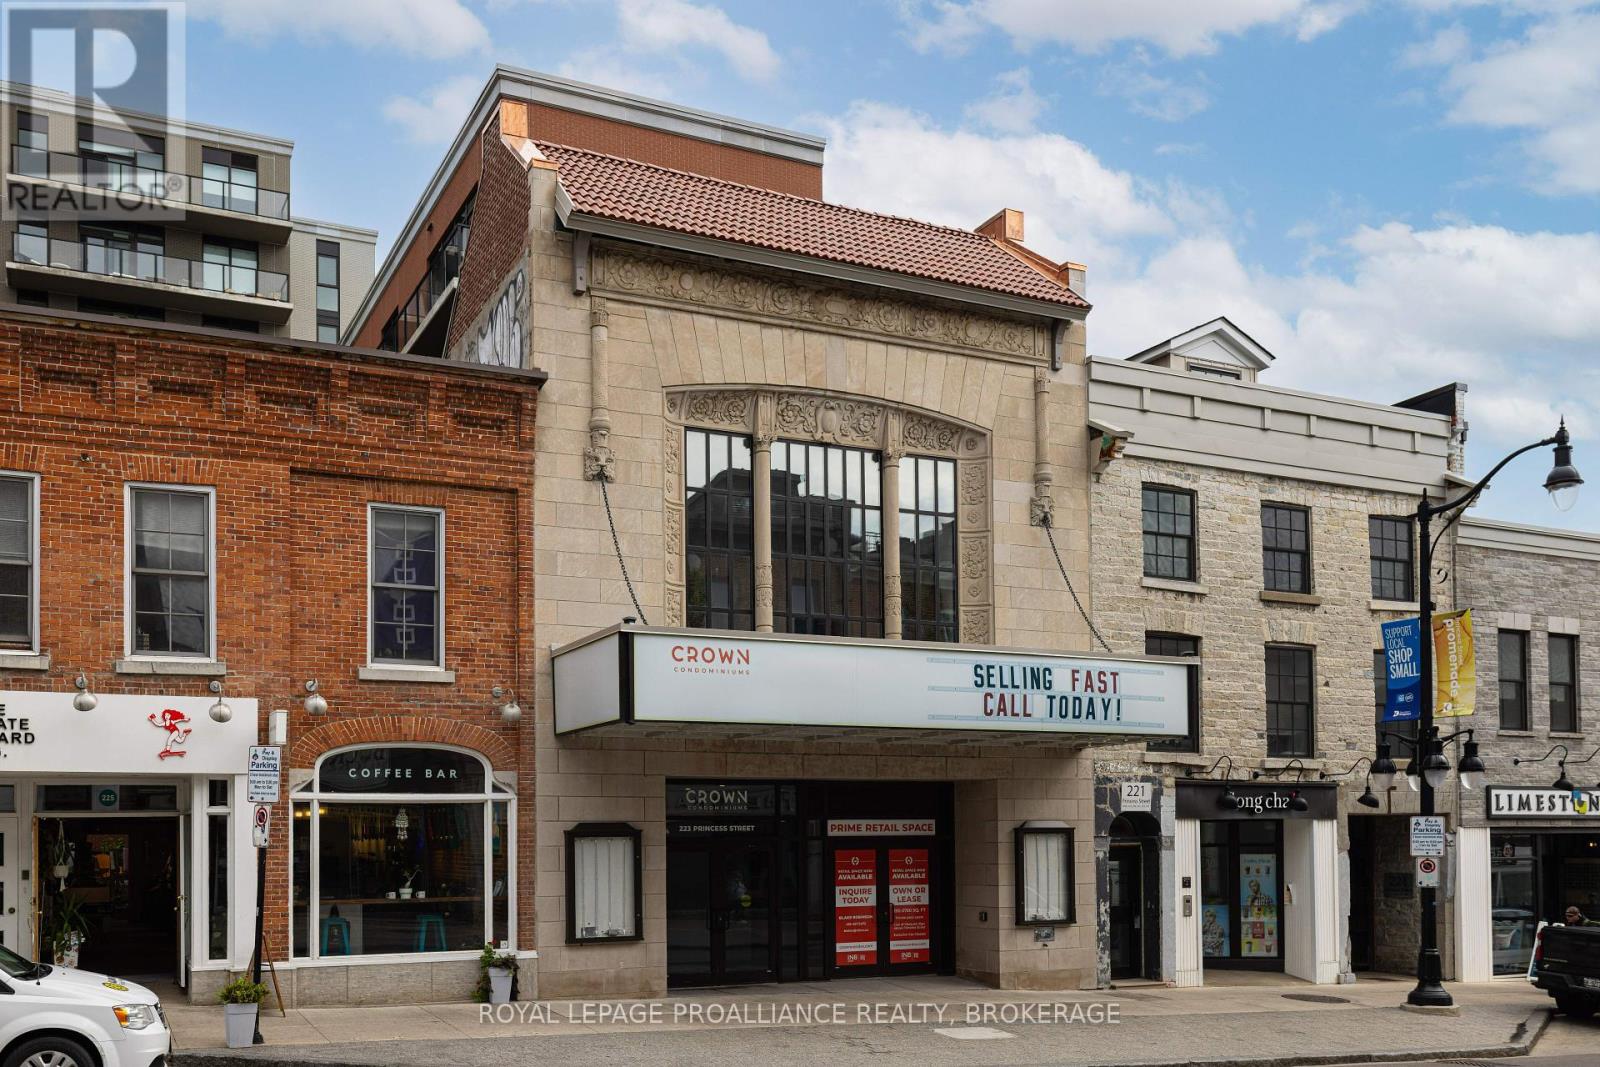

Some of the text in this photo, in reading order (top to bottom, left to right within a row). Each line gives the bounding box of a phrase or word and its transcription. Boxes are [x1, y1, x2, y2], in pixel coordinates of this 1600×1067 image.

[1385, 625, 1412, 639] SUPPORT
[1387, 638, 1406, 650] LOCAL
[672, 645, 750, 665] CROWN
[1388, 647, 1413, 664] SHOP
[1442, 618, 1460, 698] promenade
[673, 666, 750, 675] CONDOMINIUMS
[1390, 662, 1420, 679] SMALL
[974, 664, 1119, 695] SELLING FAST
[983, 692, 1121, 722] CALL TODAY!
[251, 762, 278, 771] Parking
[348, 768, 458, 779] COFFEE BAR
[686, 790, 748, 803] CROWN
[1127, 785, 1145, 797] 221
[1230, 791, 1263, 813] ong
[1494, 794, 1600, 811] LIMESTN
[830, 823, 933, 832] PRIME RETAIL SPACE
[839, 888, 873, 896] INQUIRE
